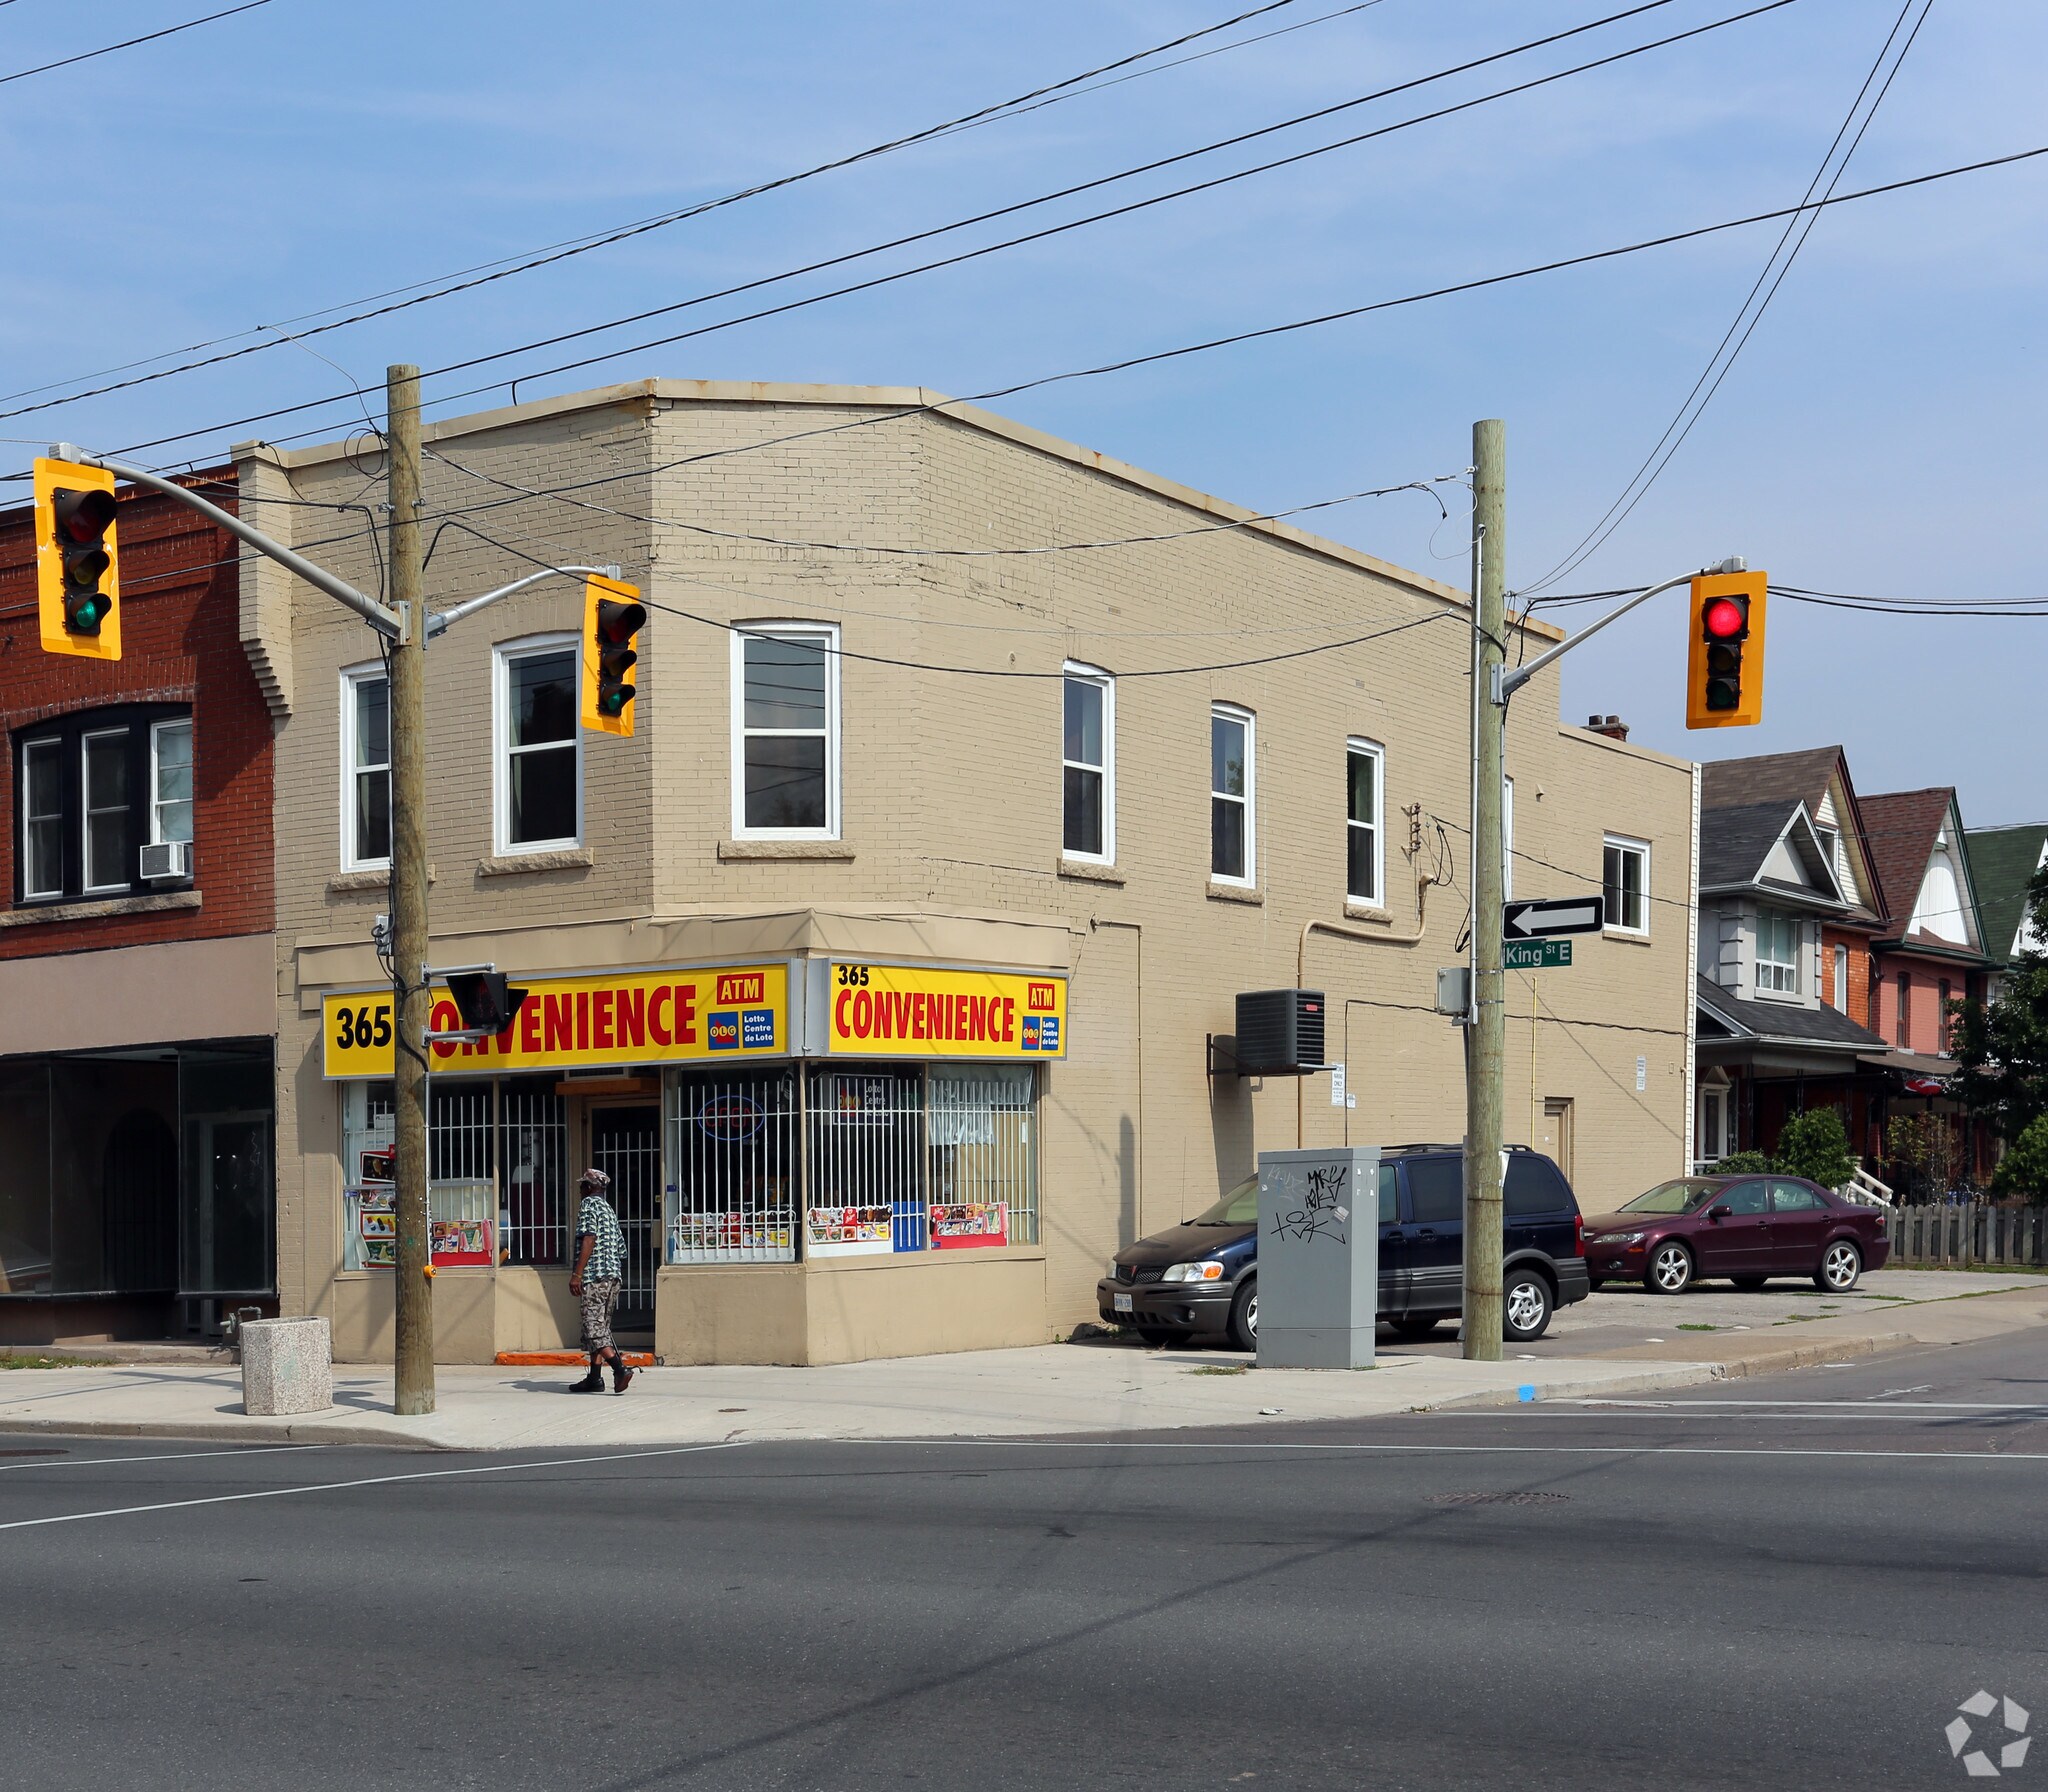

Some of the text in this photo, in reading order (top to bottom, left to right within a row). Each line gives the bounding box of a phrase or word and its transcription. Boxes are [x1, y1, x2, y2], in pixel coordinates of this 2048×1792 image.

[1506, 943, 1570, 967] King St E
[836, 965, 869, 986] 365
[720, 978, 760, 1001] ATM
[1030, 987, 1053, 1007] ATM
[744, 1015, 766, 1023] Lotto
[835, 988, 1014, 1043] CONVENIENCE
[335, 1005, 392, 1050] 365
[709, 1025, 737, 1038] OLG
[744, 1024, 772, 1033] Centre
[744, 1033, 773, 1042] de Loto
[1043, 1029, 1058, 1037] Centre
